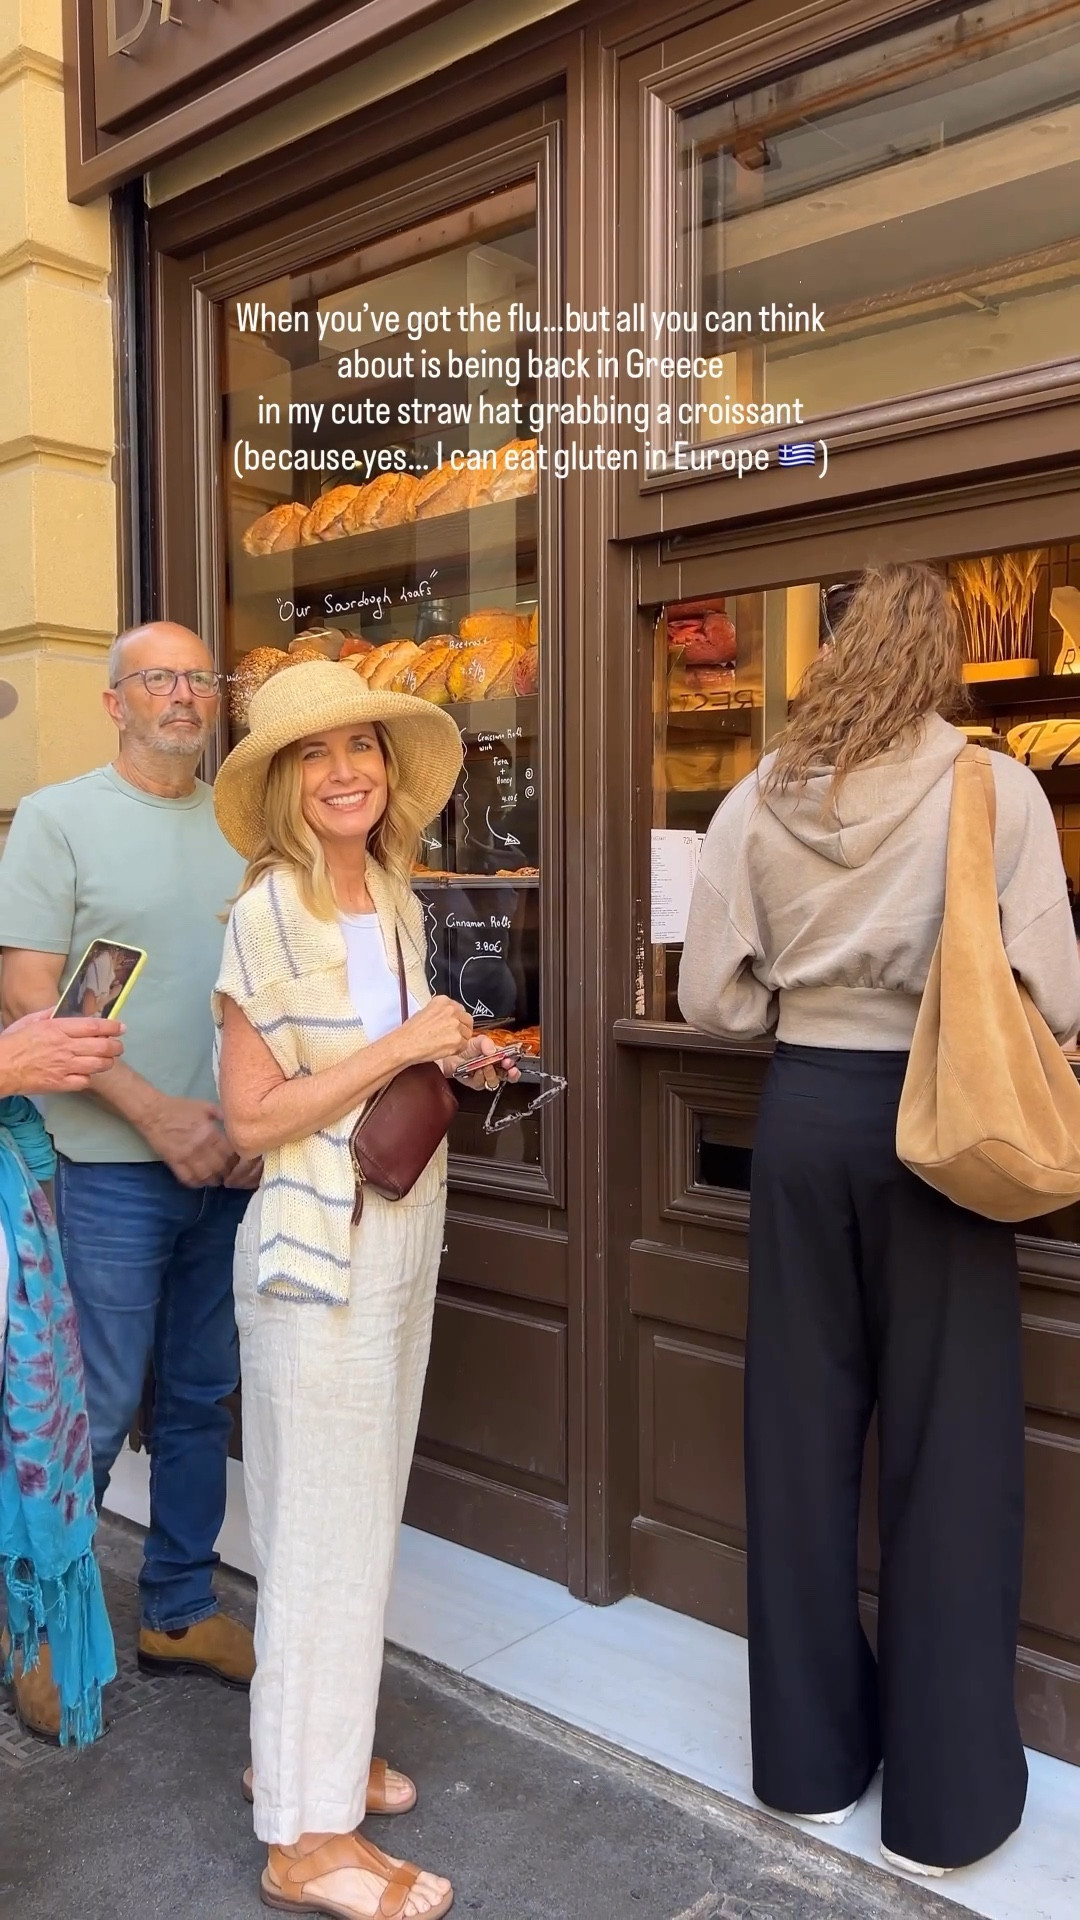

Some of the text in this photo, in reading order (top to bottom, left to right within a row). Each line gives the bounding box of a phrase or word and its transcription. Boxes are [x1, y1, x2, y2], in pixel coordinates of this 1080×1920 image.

[324, 587, 392, 620] Sourdough
[493, 756, 509, 766] Feta
[496, 776, 513, 787] Honey
[445, 912, 486, 929] Cinnamon
[490, 915, 512, 929] Rolls
[474, 940, 503, 953] 3.80€
